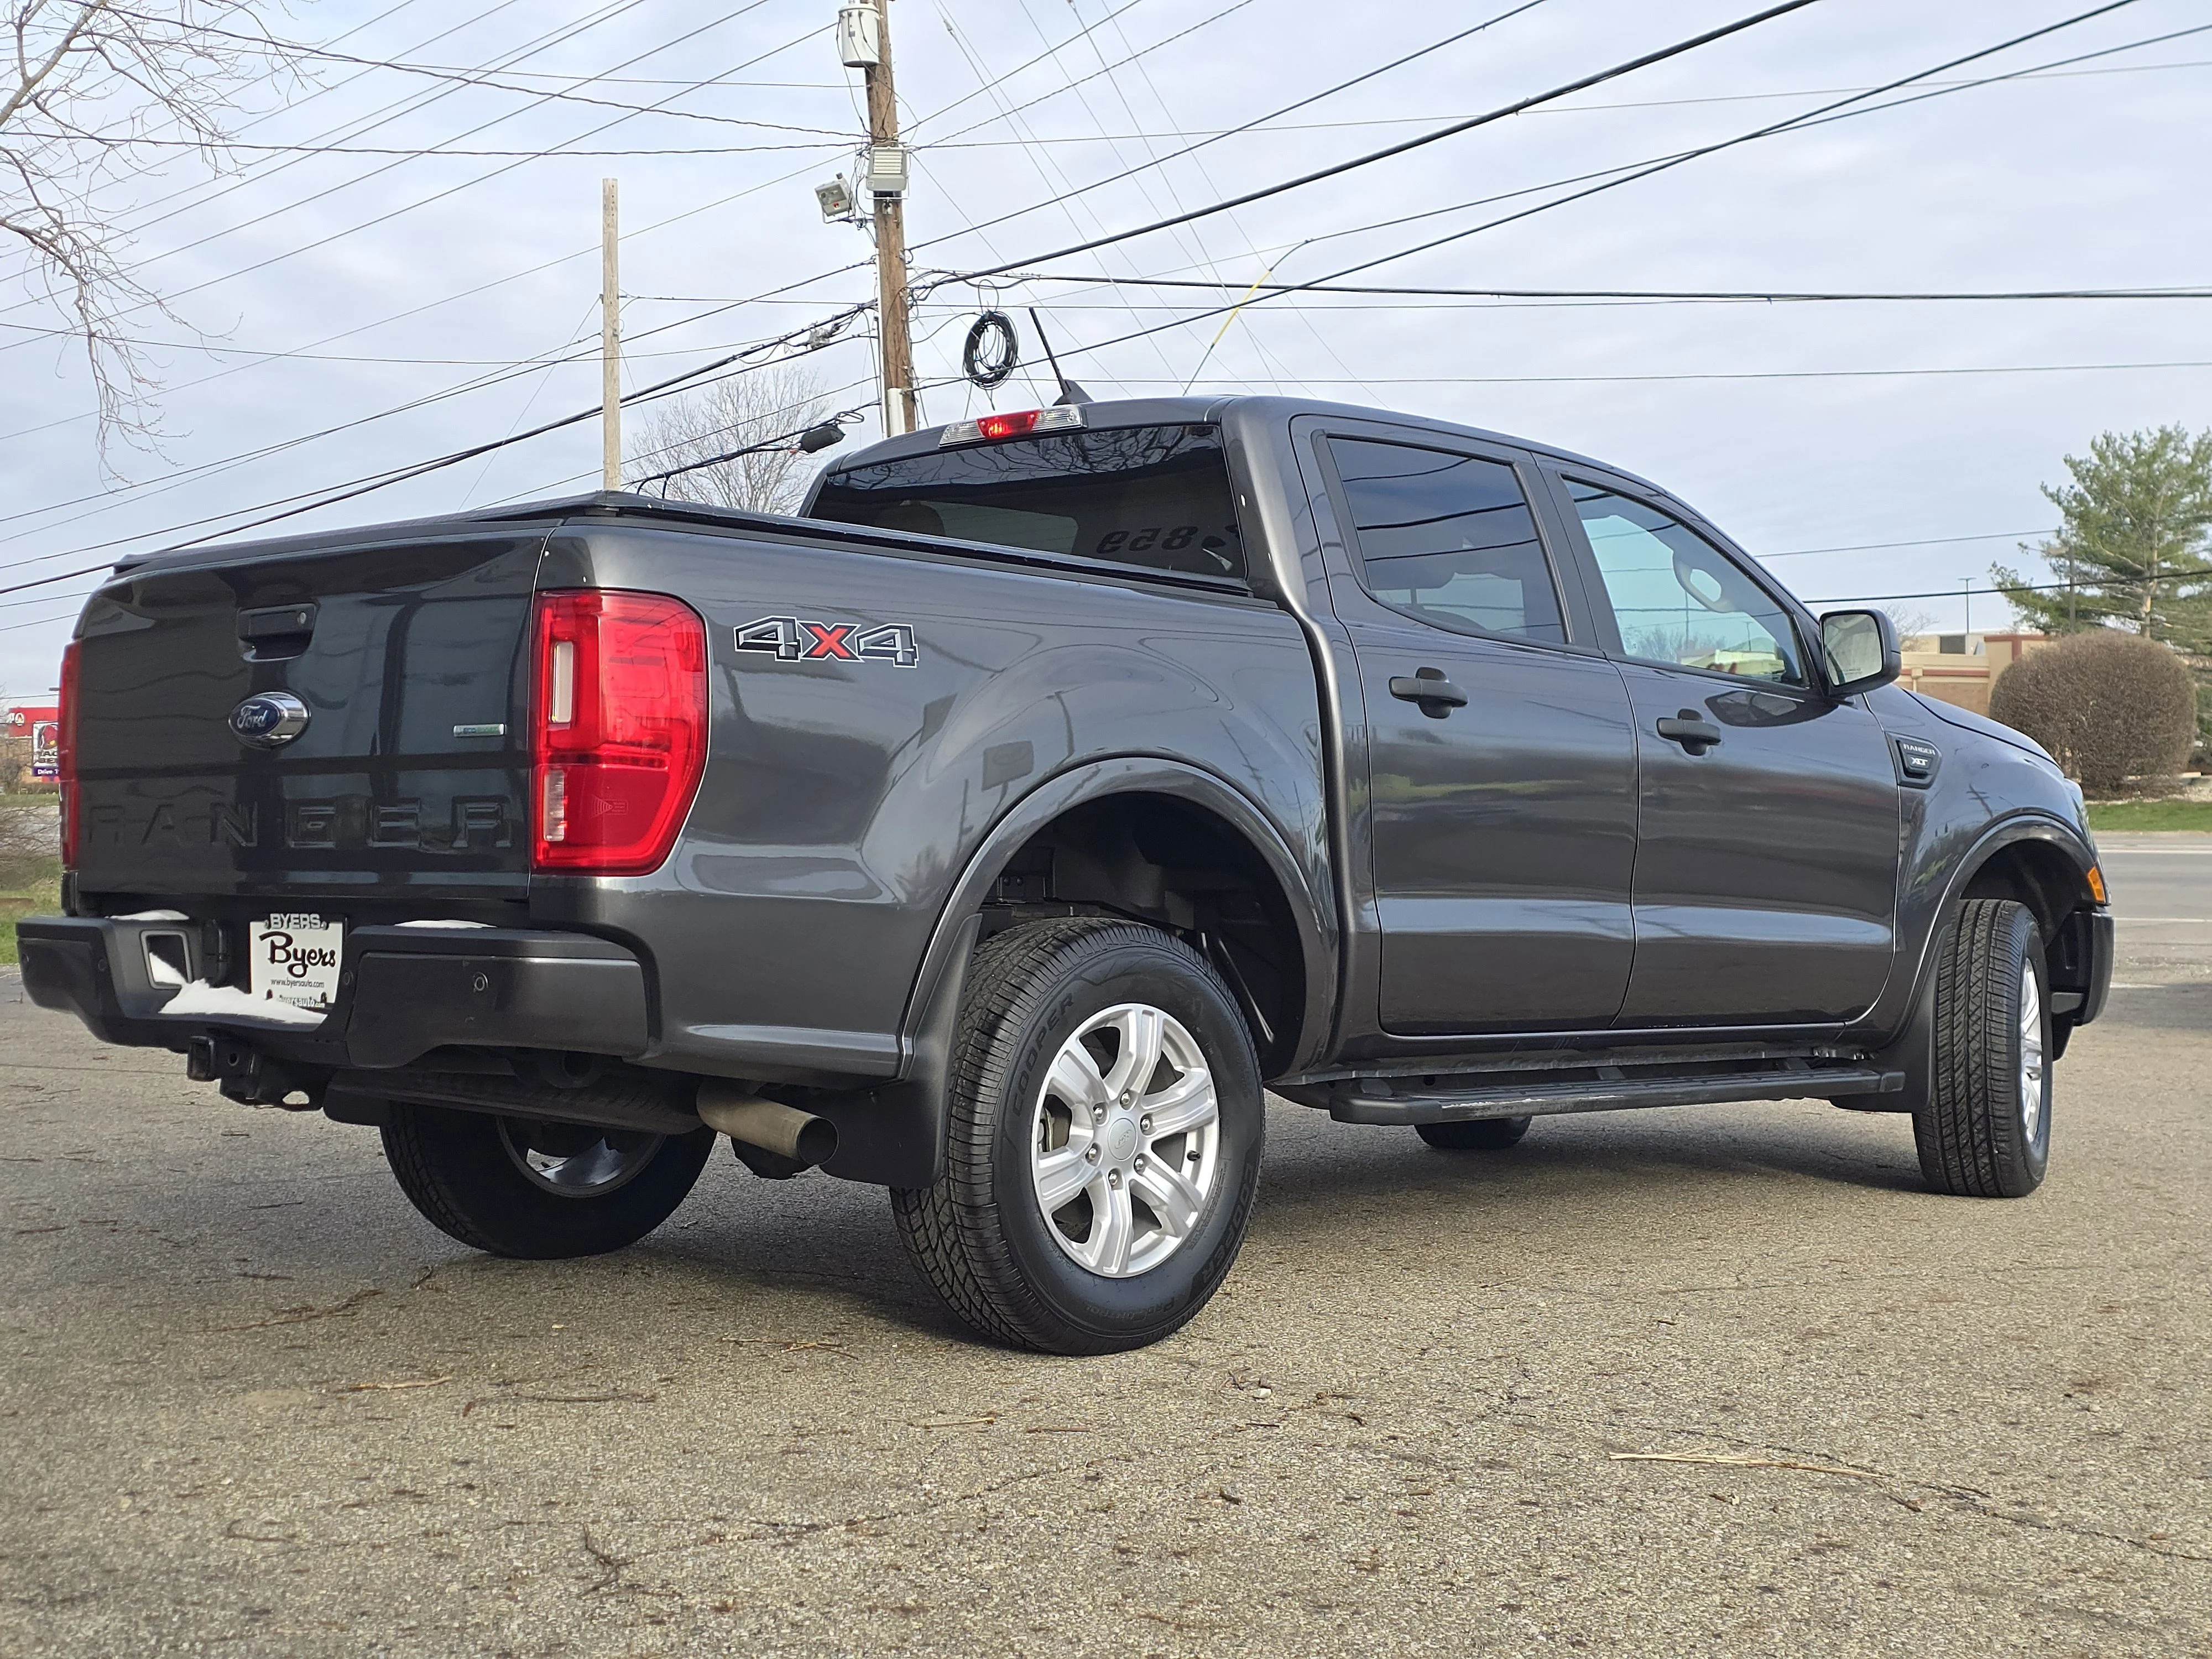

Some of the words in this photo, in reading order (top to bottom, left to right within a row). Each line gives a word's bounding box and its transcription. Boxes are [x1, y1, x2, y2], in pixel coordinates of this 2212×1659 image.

[236, 705, 268, 729] Ford
[1903, 743, 1936, 755] RANGER
[1910, 757, 1928, 766] XLT
[88, 796, 512, 848] RANGER
[270, 913, 321, 930] BYERS
[258, 931, 336, 978] Byers
[270, 977, 325, 988] www.byersauto.com
